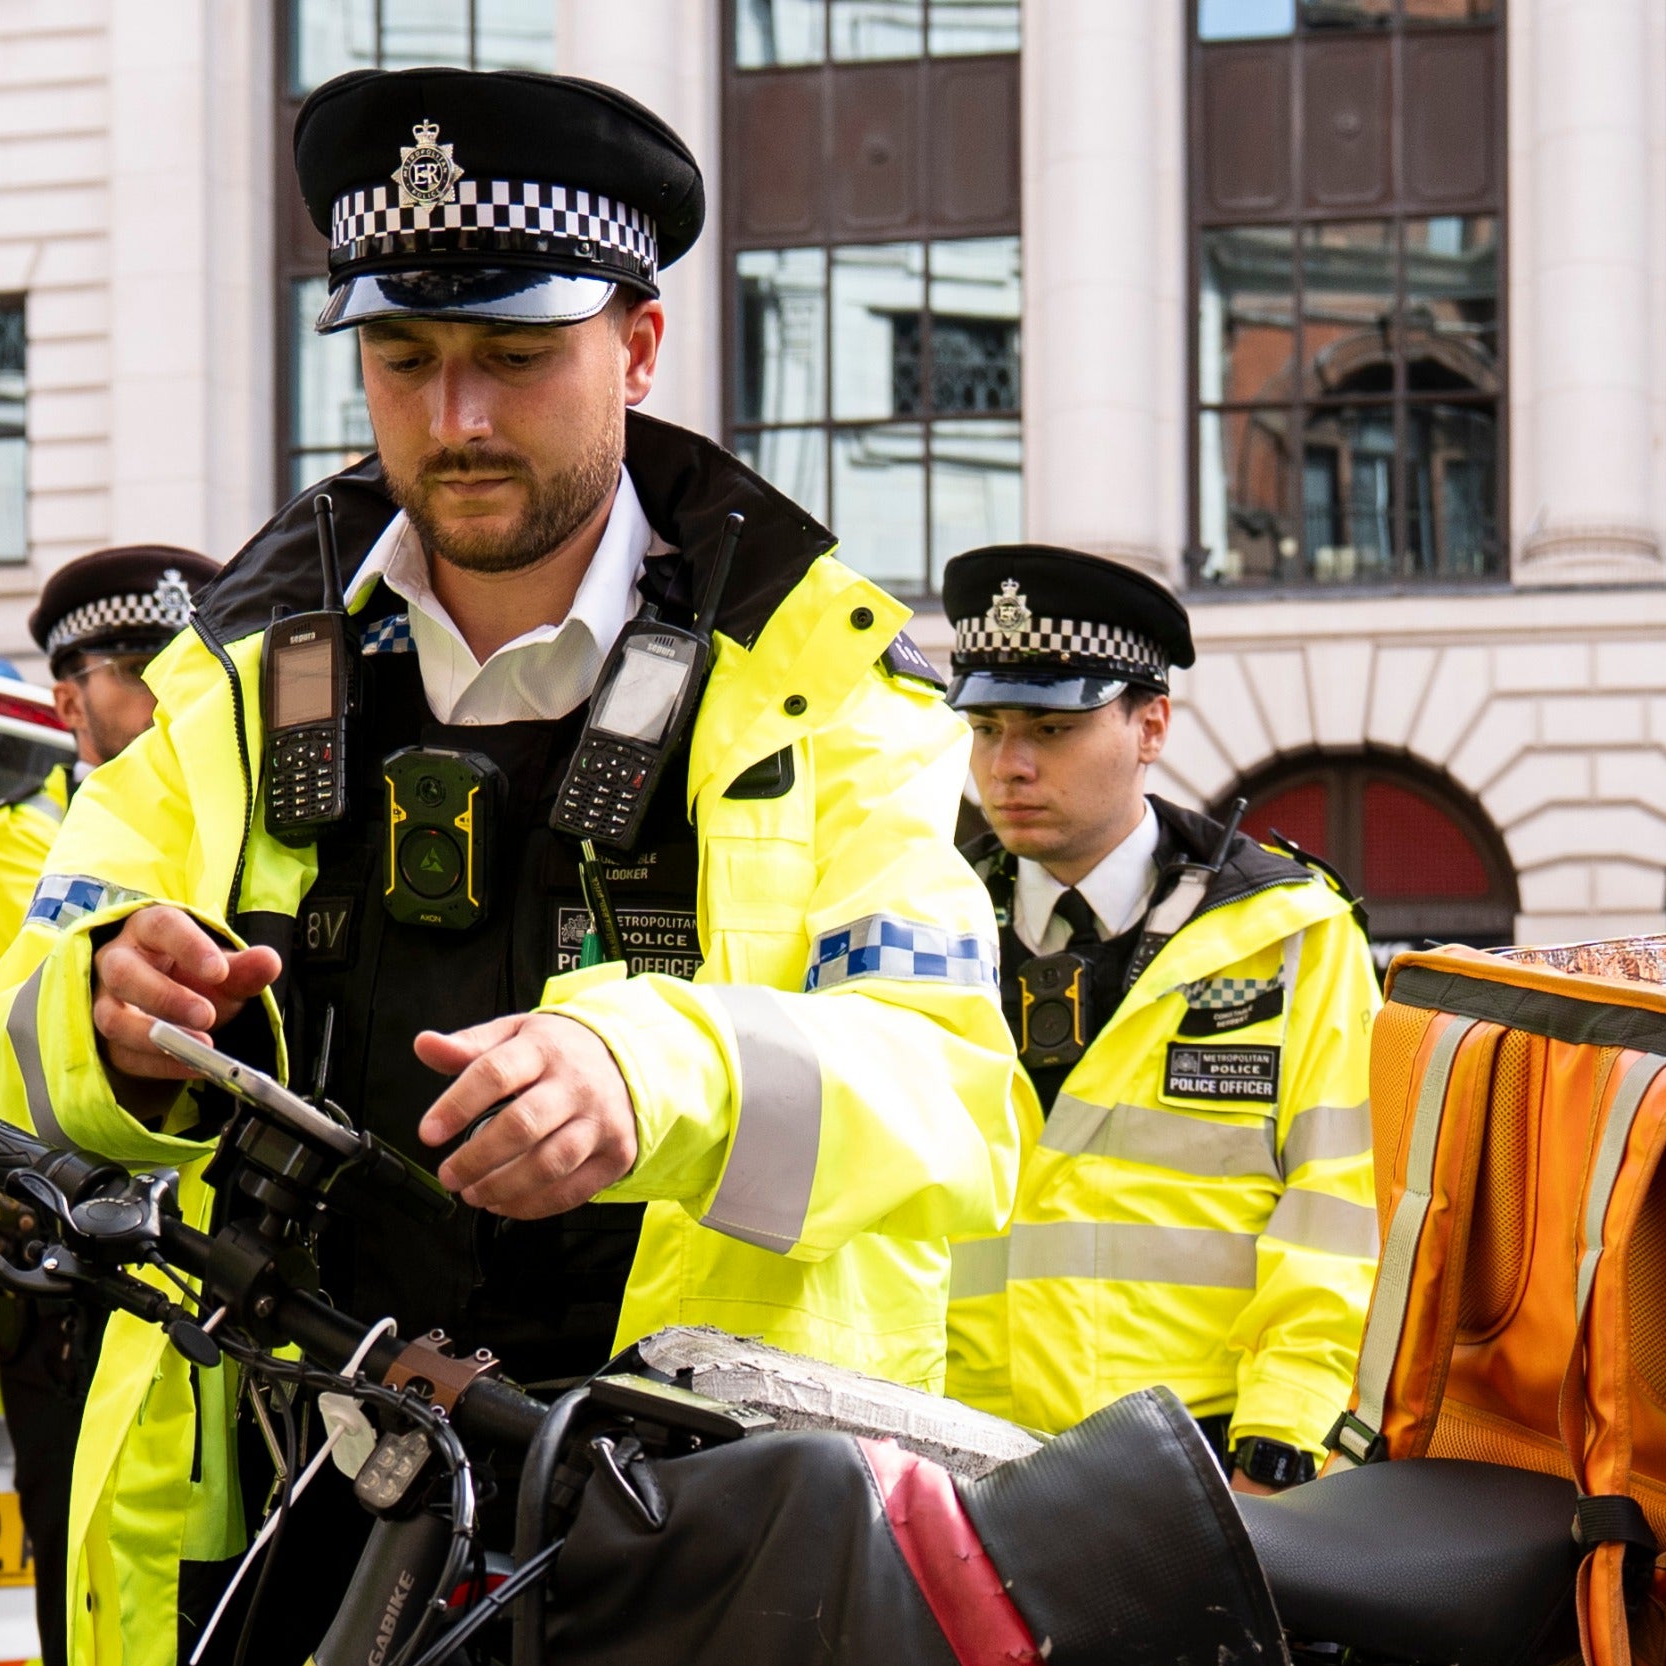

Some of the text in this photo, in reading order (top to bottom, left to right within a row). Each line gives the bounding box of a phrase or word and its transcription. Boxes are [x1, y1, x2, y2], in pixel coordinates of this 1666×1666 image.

[413, 163, 440, 186] ER
[290, 631, 316, 645] sepura
[646, 642, 675, 658] sepura
[605, 868, 649, 881] LOOKER
[420, 914, 442, 924] AXON
[617, 915, 697, 930] ETROPOLITAN
[1202, 1054, 1270, 1064] METROPOLITAN
[1210, 1065, 1261, 1075] POLICE
[1170, 1078, 1273, 1096] POLICE OFFICER
